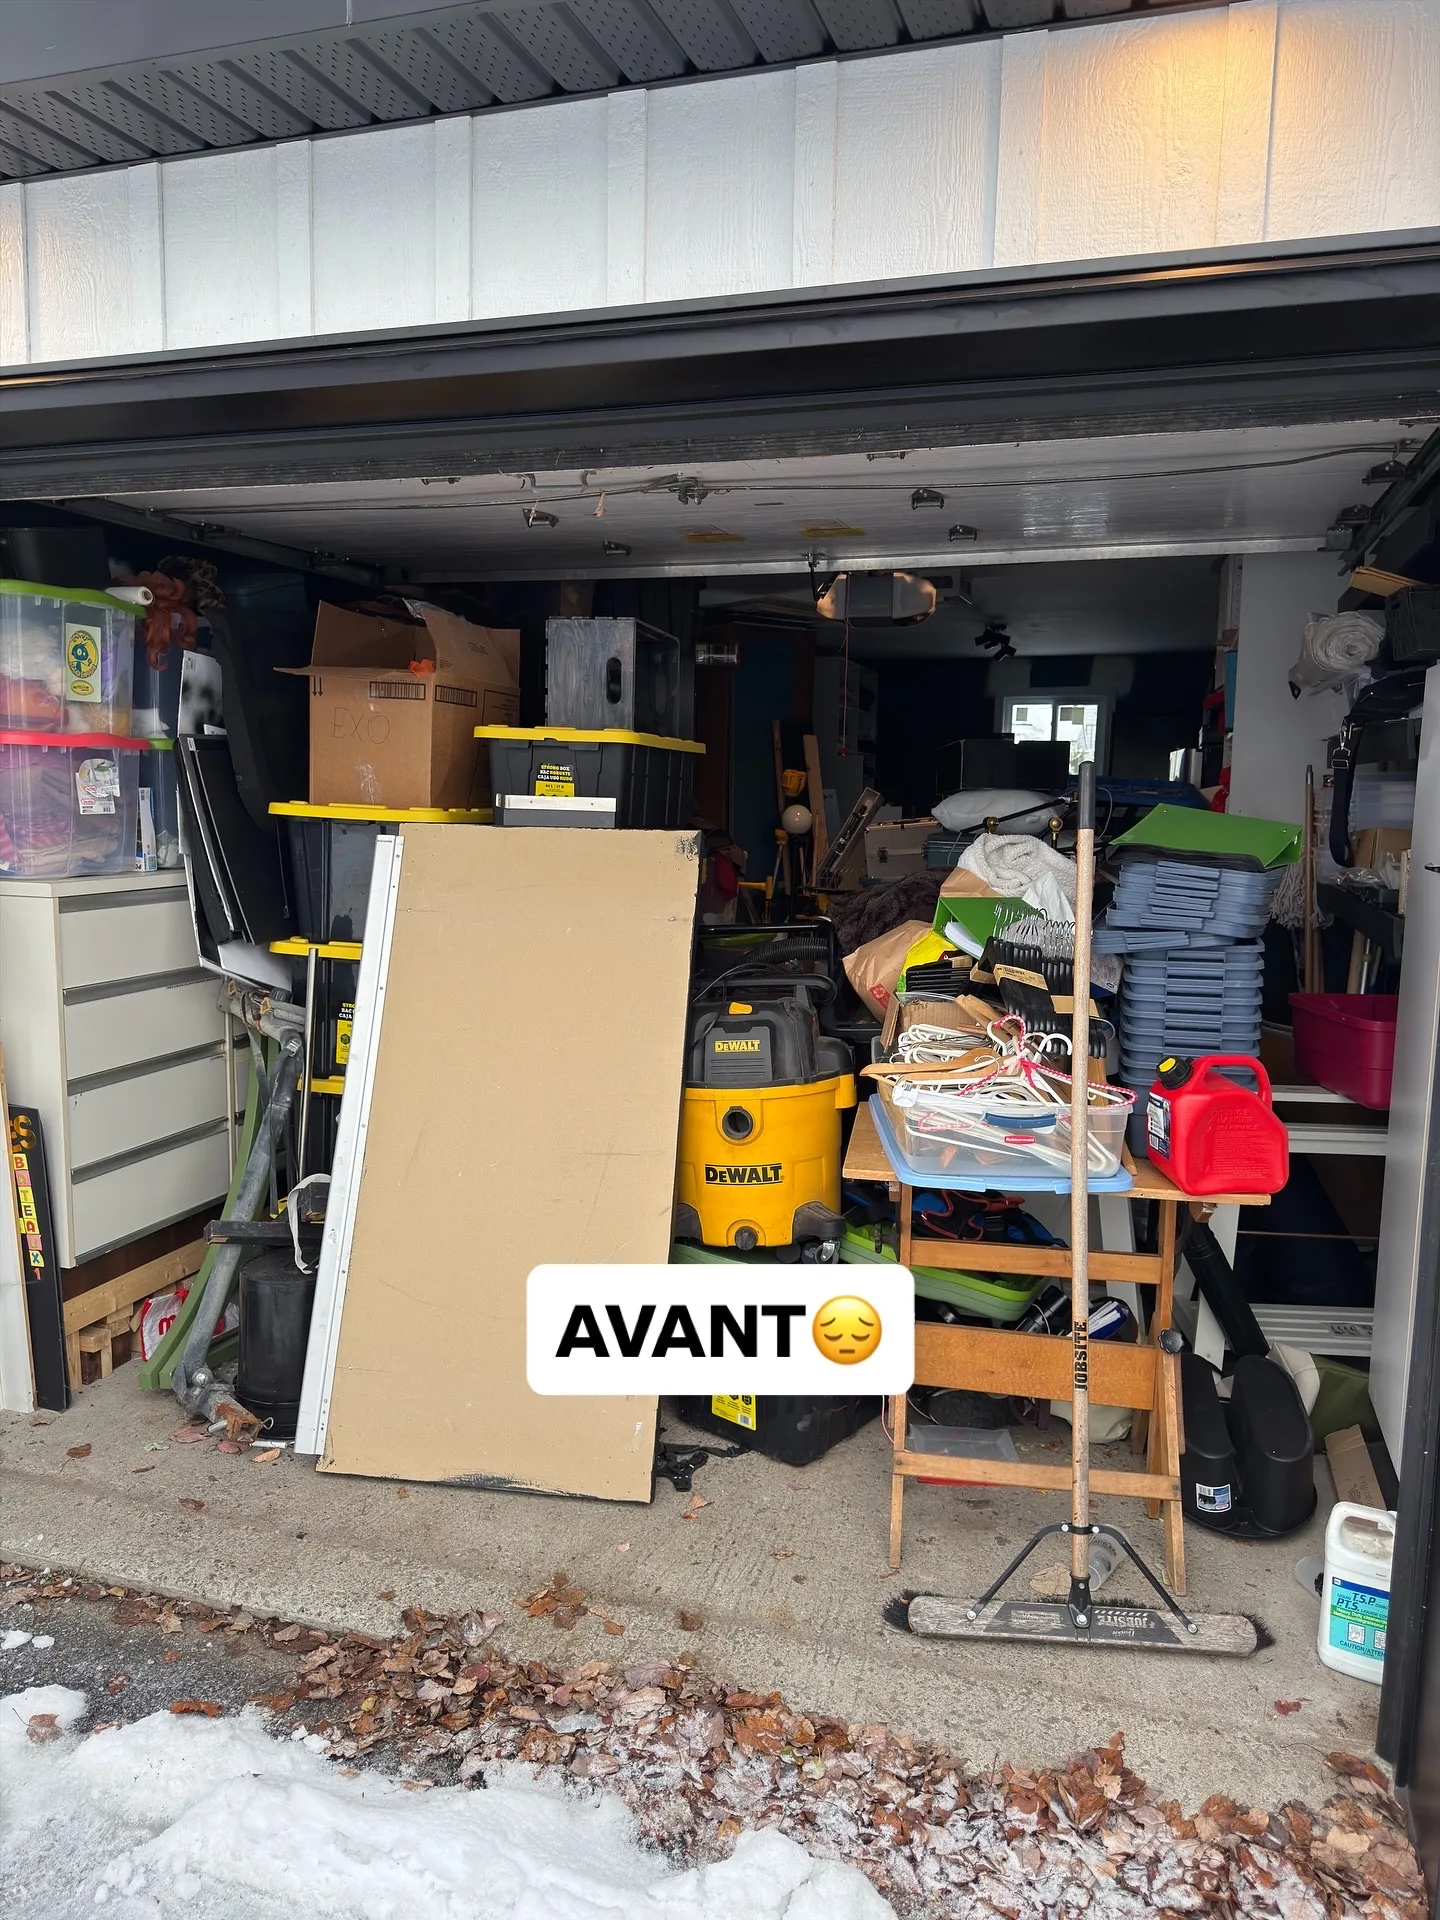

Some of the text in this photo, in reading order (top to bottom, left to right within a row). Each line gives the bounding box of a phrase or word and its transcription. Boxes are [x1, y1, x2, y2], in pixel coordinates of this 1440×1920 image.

[333, 707, 390, 744] EXO
[1073, 1321, 1088, 1391] JOBSITE
[1337, 1593, 1351, 1601] LIQUID
[1352, 1592, 1376, 1606] T.S.P.
[1337, 1597, 1360, 1611] P.T.S.
[1361, 1609, 1379, 1617] LIQUIDE
[1336, 1607, 1350, 1616] Heavy
[1351, 1611, 1363, 1619] Duty
